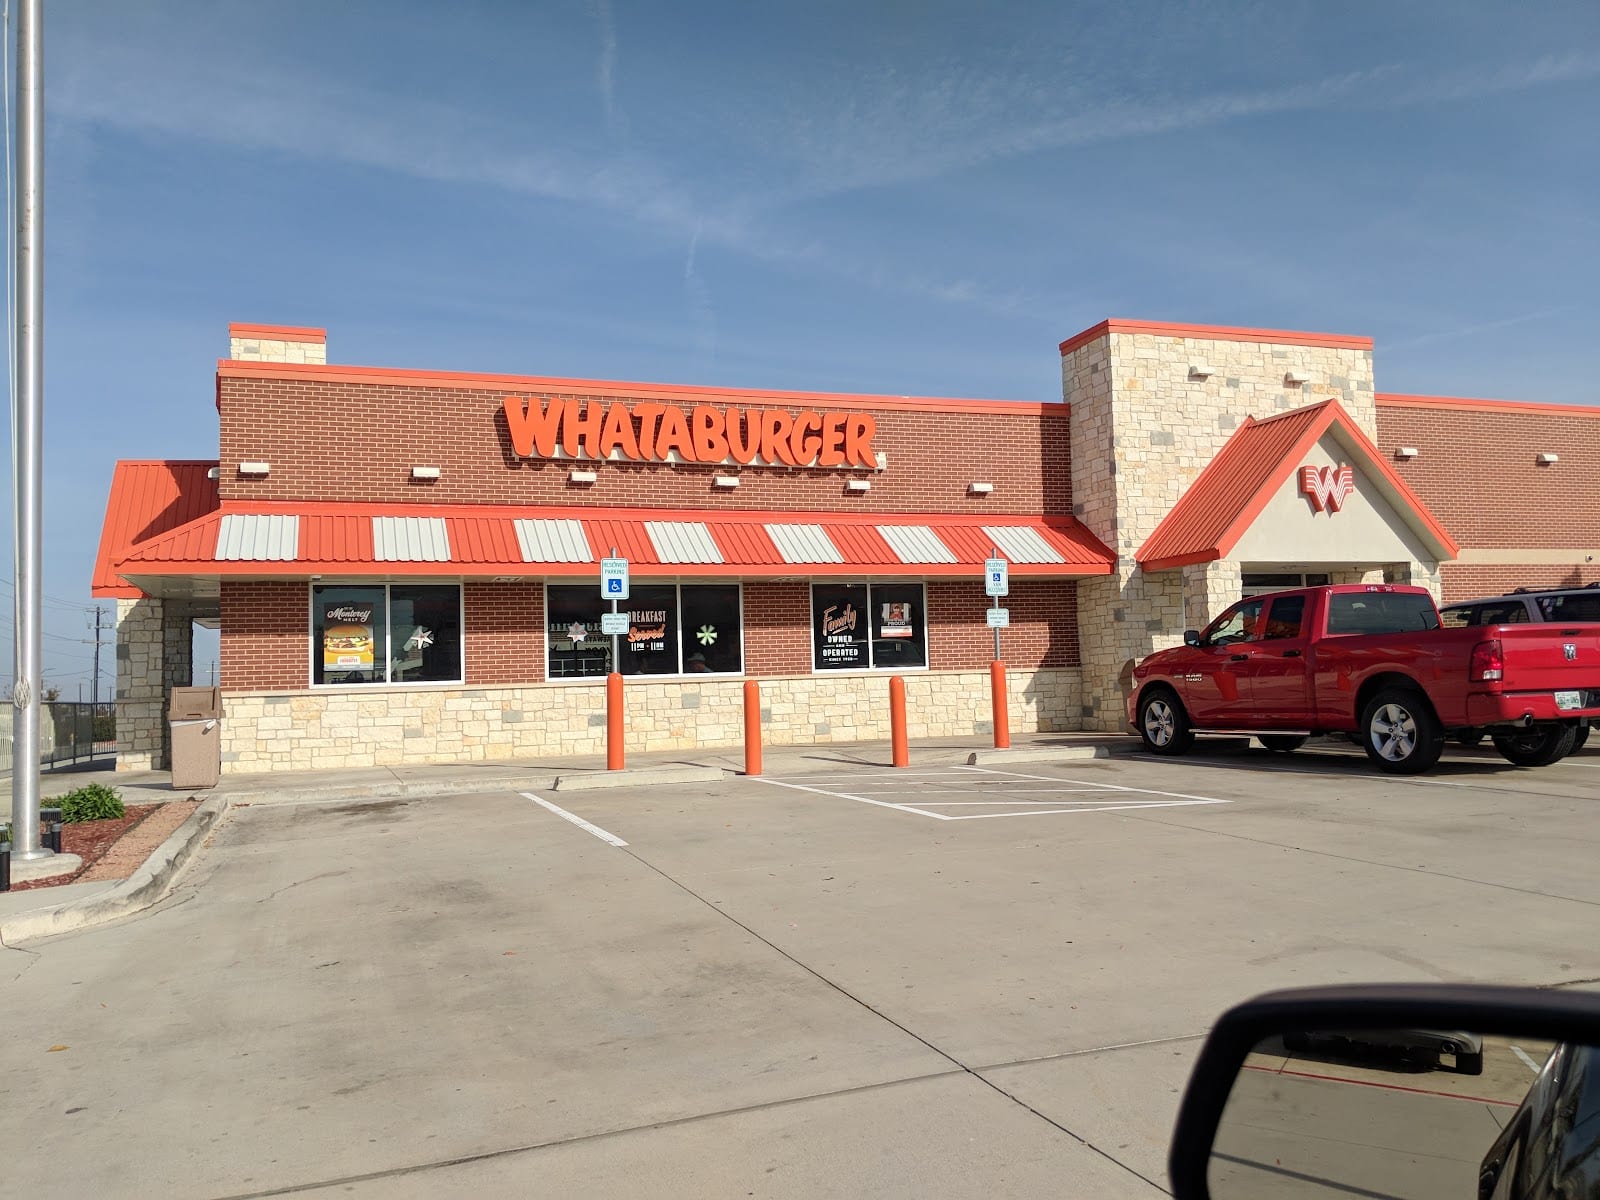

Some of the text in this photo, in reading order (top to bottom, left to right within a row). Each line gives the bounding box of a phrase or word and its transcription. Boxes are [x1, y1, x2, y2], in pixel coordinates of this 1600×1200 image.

[503, 396, 877, 467] WHATABURGER
[327, 607, 371, 622] Monterey
[822, 604, 857, 636] Family
[827, 635, 853, 643] OWNED
[822, 648, 859, 657] OPERATED
